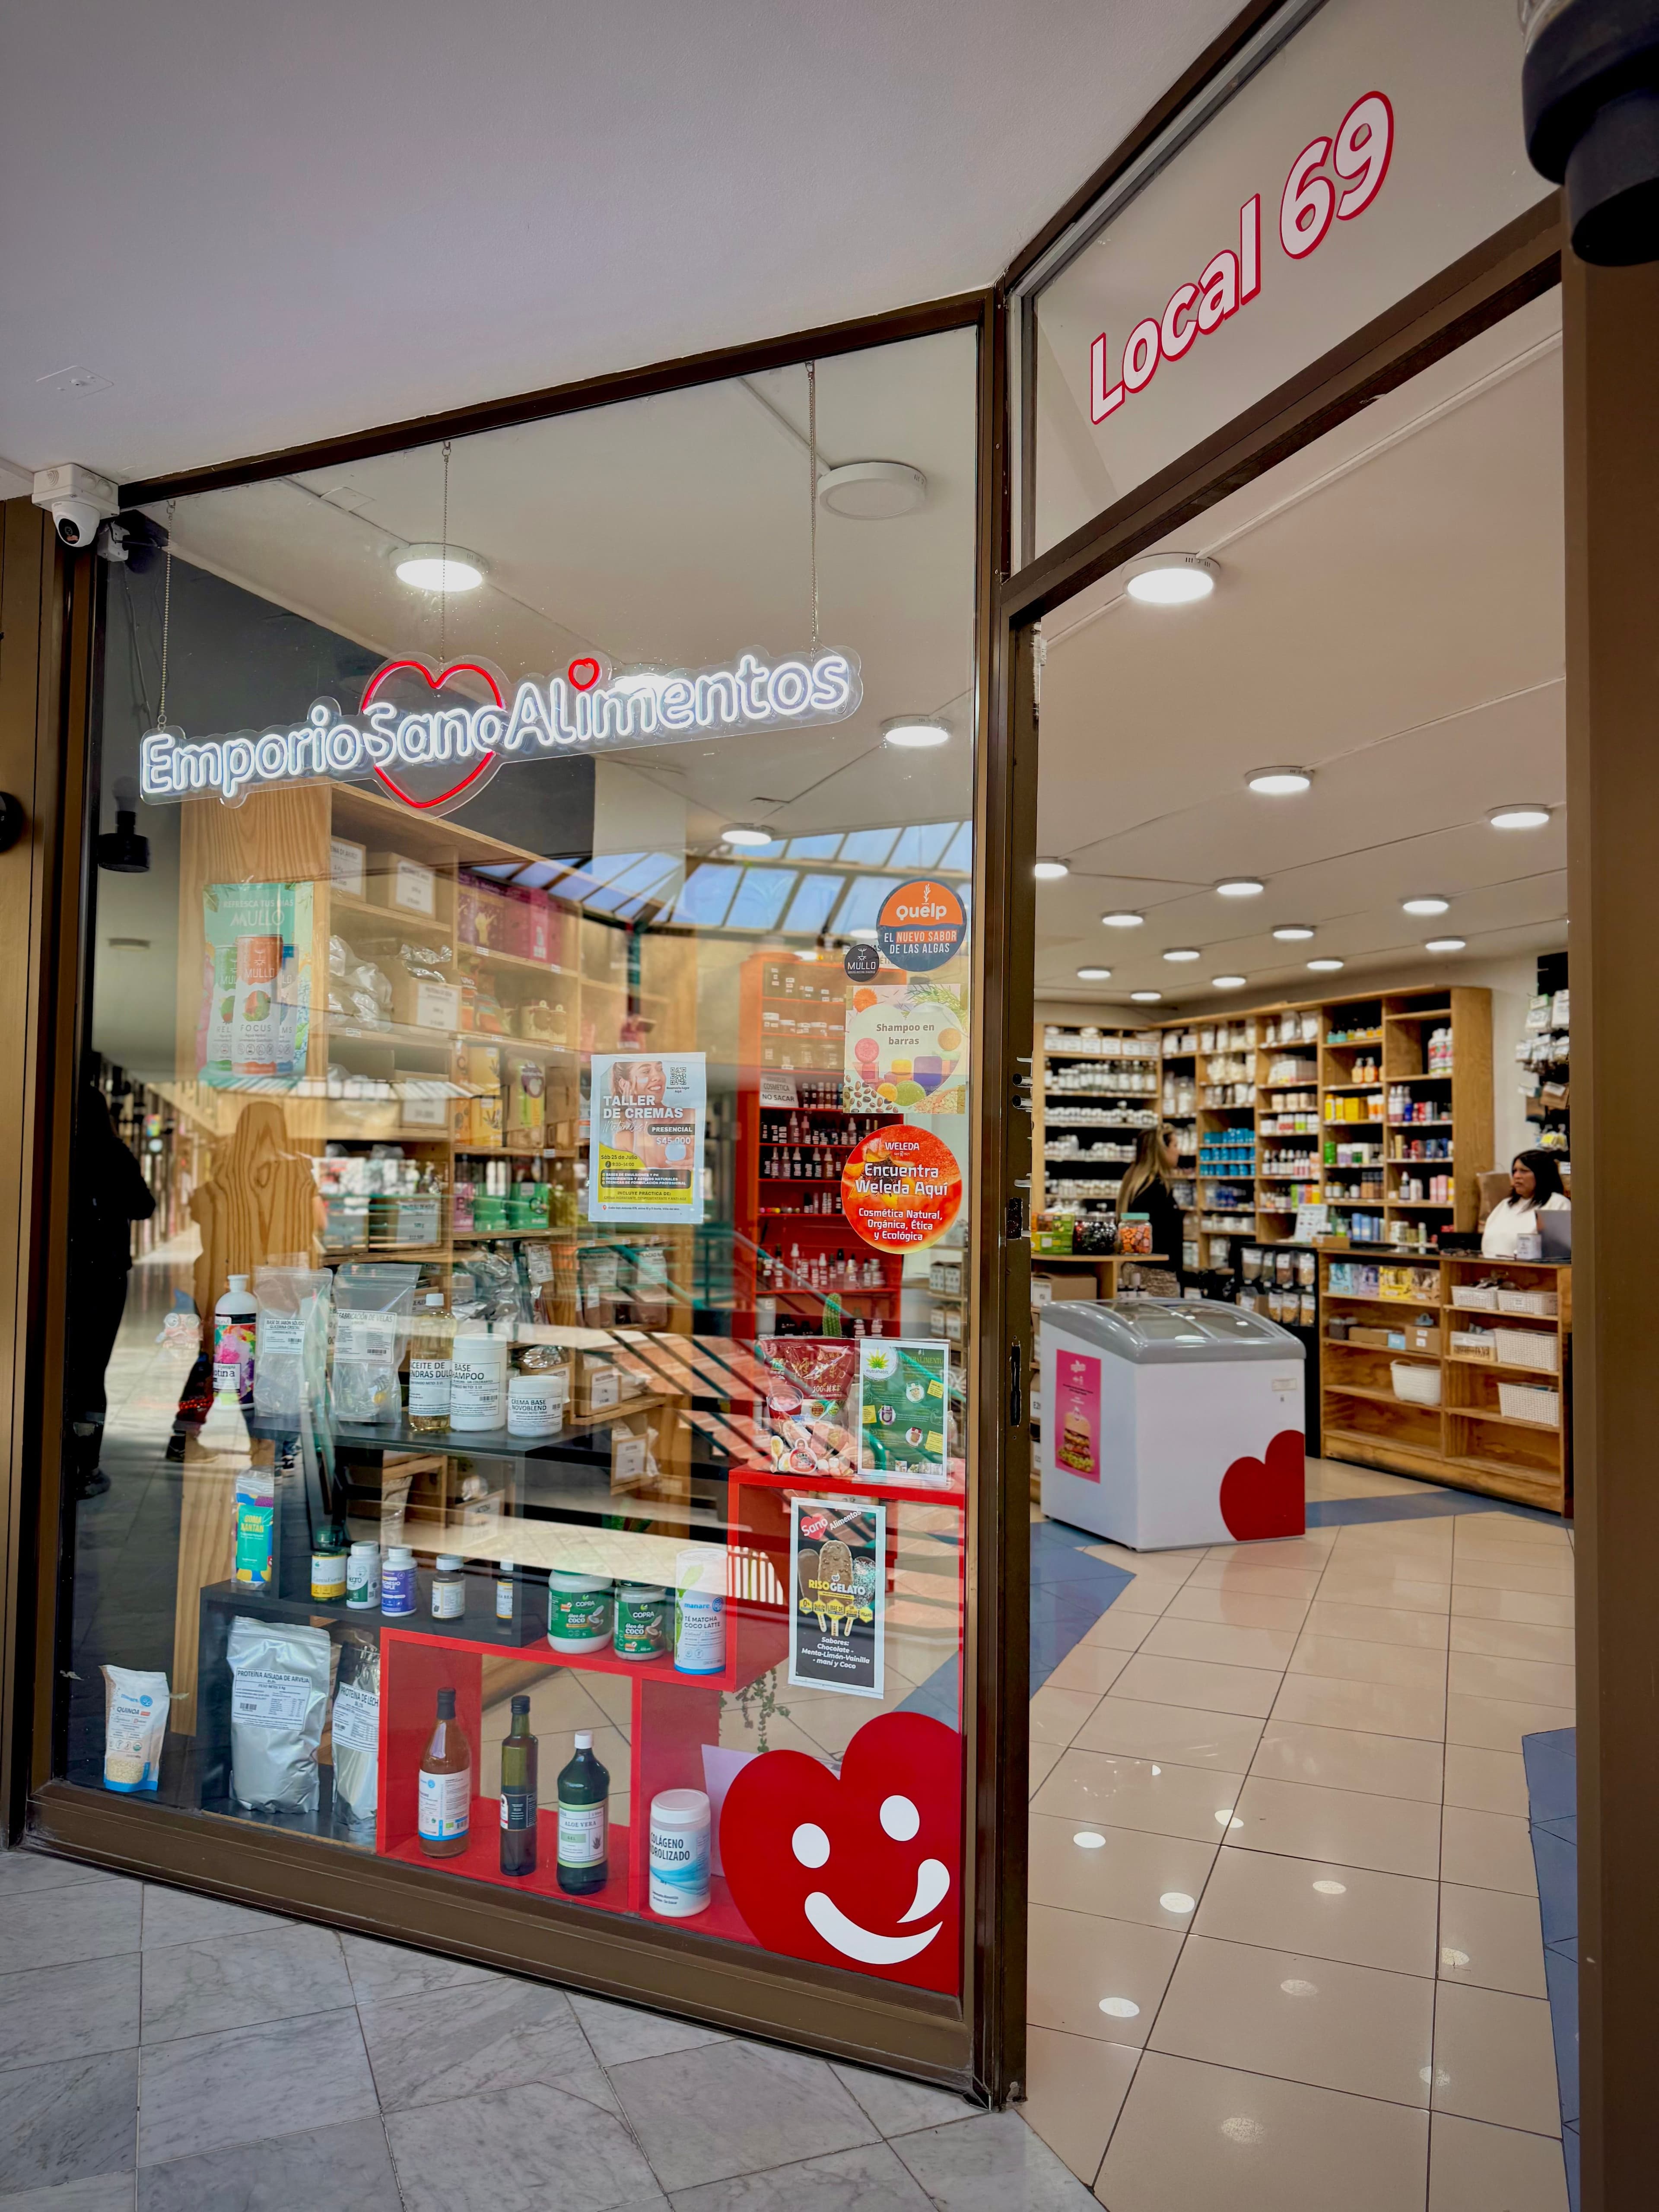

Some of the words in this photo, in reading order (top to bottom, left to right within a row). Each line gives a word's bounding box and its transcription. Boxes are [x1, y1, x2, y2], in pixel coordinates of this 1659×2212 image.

[1091, 193, 1261, 425] Local
[1280, 91, 1394, 259] 69
[896, 903, 947, 920] Quelp
[230, 910, 285, 927] MULLO
[884, 933, 893, 942] EL
[897, 931, 925, 942] NUEVO
[928, 931, 957, 941] SABOR
[890, 944, 899, 954] DE
[903, 943, 919, 954] LAS
[922, 943, 950, 953] ALGAS
[245, 968, 274, 979] MULLO
[877, 1023, 920, 1033] Shampoo
[603, 1095, 655, 1106] TALLER
[604, 1108, 620, 1118] DE
[625, 1108, 683, 1118] CREMAS
[885, 1142, 919, 1150] WELEDA
[864, 1163, 938, 1177] Encuentra
[855, 1180, 909, 1194] Weleda
[915, 1182, 947, 1198] Aquí
[859, 1208, 903, 1217] Cosmética
[907, 1210, 942, 1220] Natural,
[868, 1219, 908, 1230] Orgánica,
[912, 1220, 933, 1230] Ética
[882, 1231, 922, 1242] Ecológica
[801, 1518, 828, 1536] Sano
[830, 1510, 861, 1530] Alimentos
[809, 1579, 865, 1595] RISOGELATO
[821, 1637, 849, 1646] Sabores:
[817, 1643, 849, 1653] Chocolate
[801, 1648, 870, 1663] Menta-Limón-Vainilla
[651, 1832, 683, 1849] COLÁGENO
